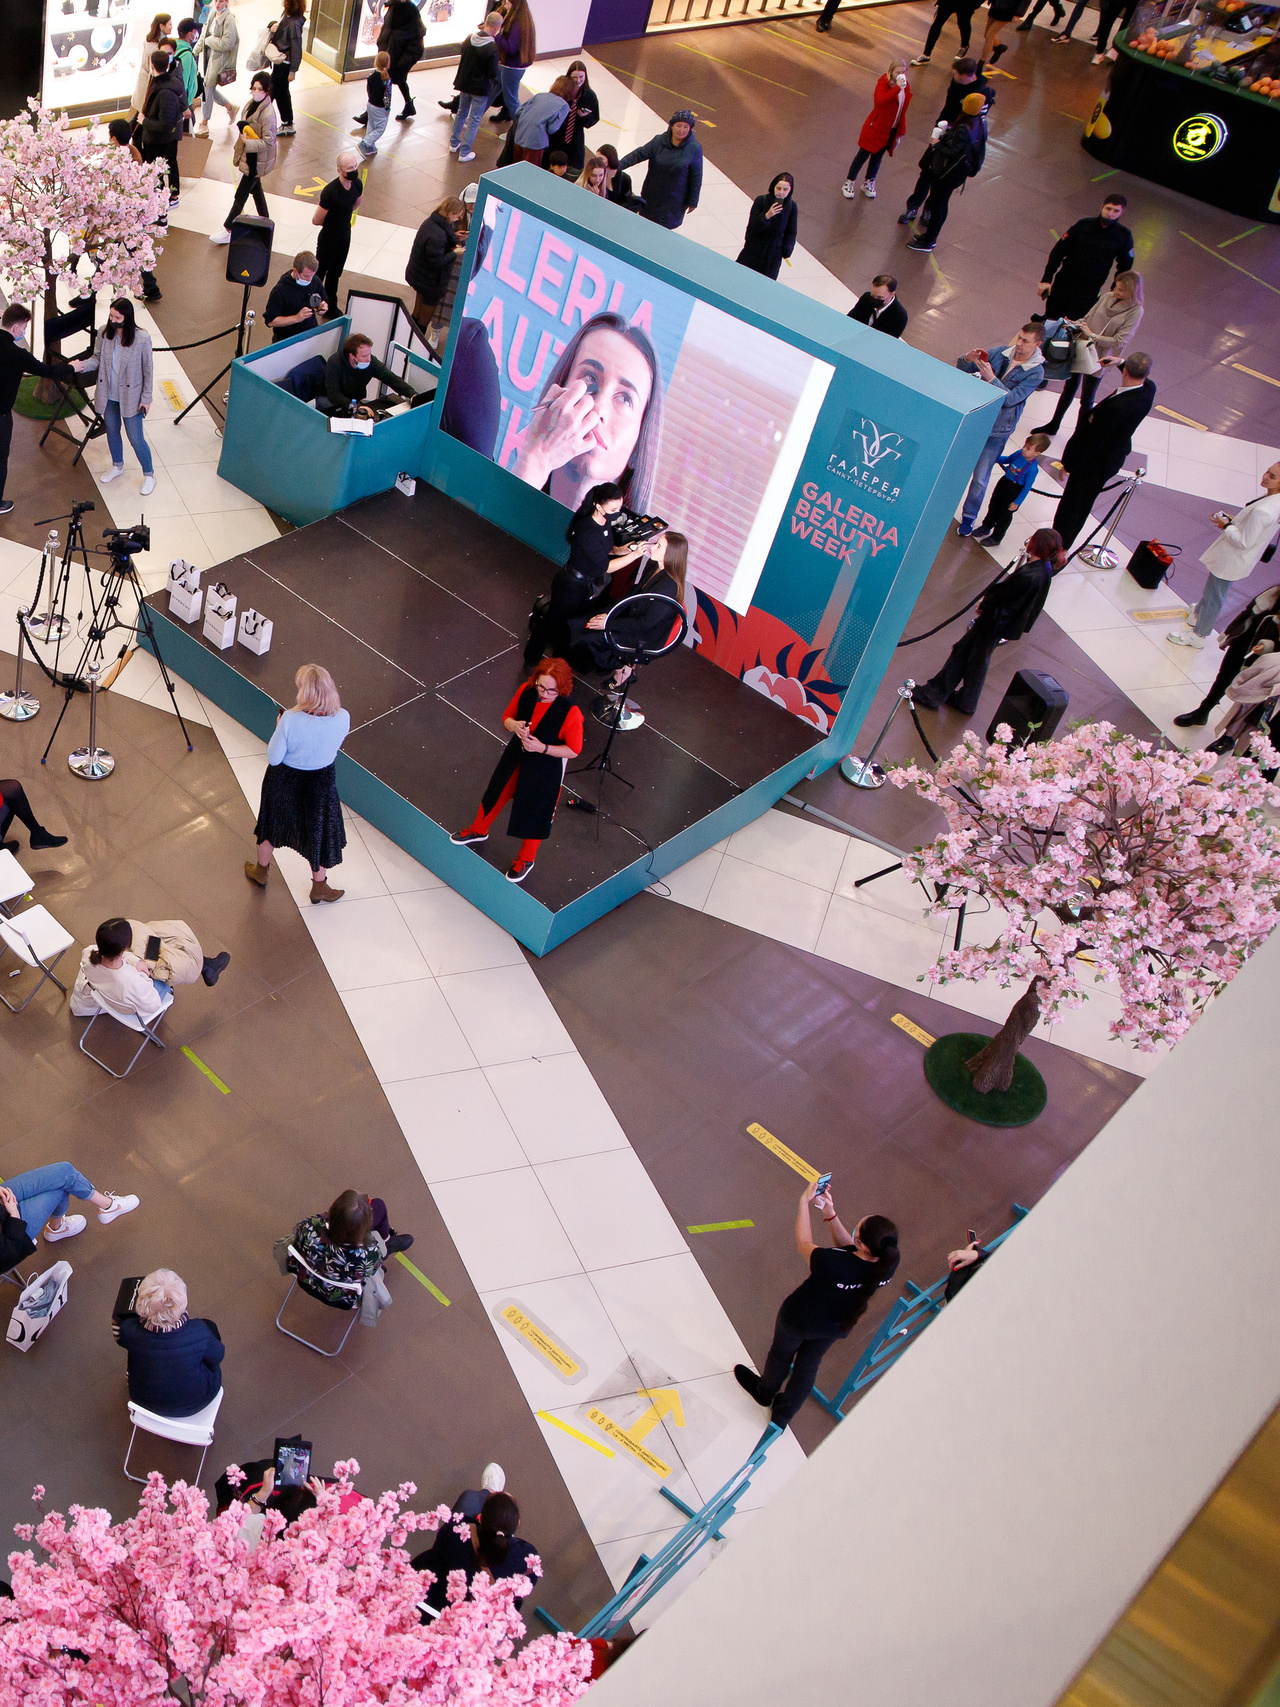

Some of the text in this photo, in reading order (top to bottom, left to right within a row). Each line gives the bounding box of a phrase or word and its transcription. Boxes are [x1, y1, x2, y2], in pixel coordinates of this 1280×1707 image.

[826, 465, 896, 504] САНКТ-ПЕТЕРБУРГ
[829, 454, 901, 498] ГАЛЕРЕЯ
[794, 498, 886, 557] BEAUTY
[802, 482, 898, 547] GALERIA
[791, 515, 856, 566] WEEK
[836, 1279, 892, 1290] GIVEHY
